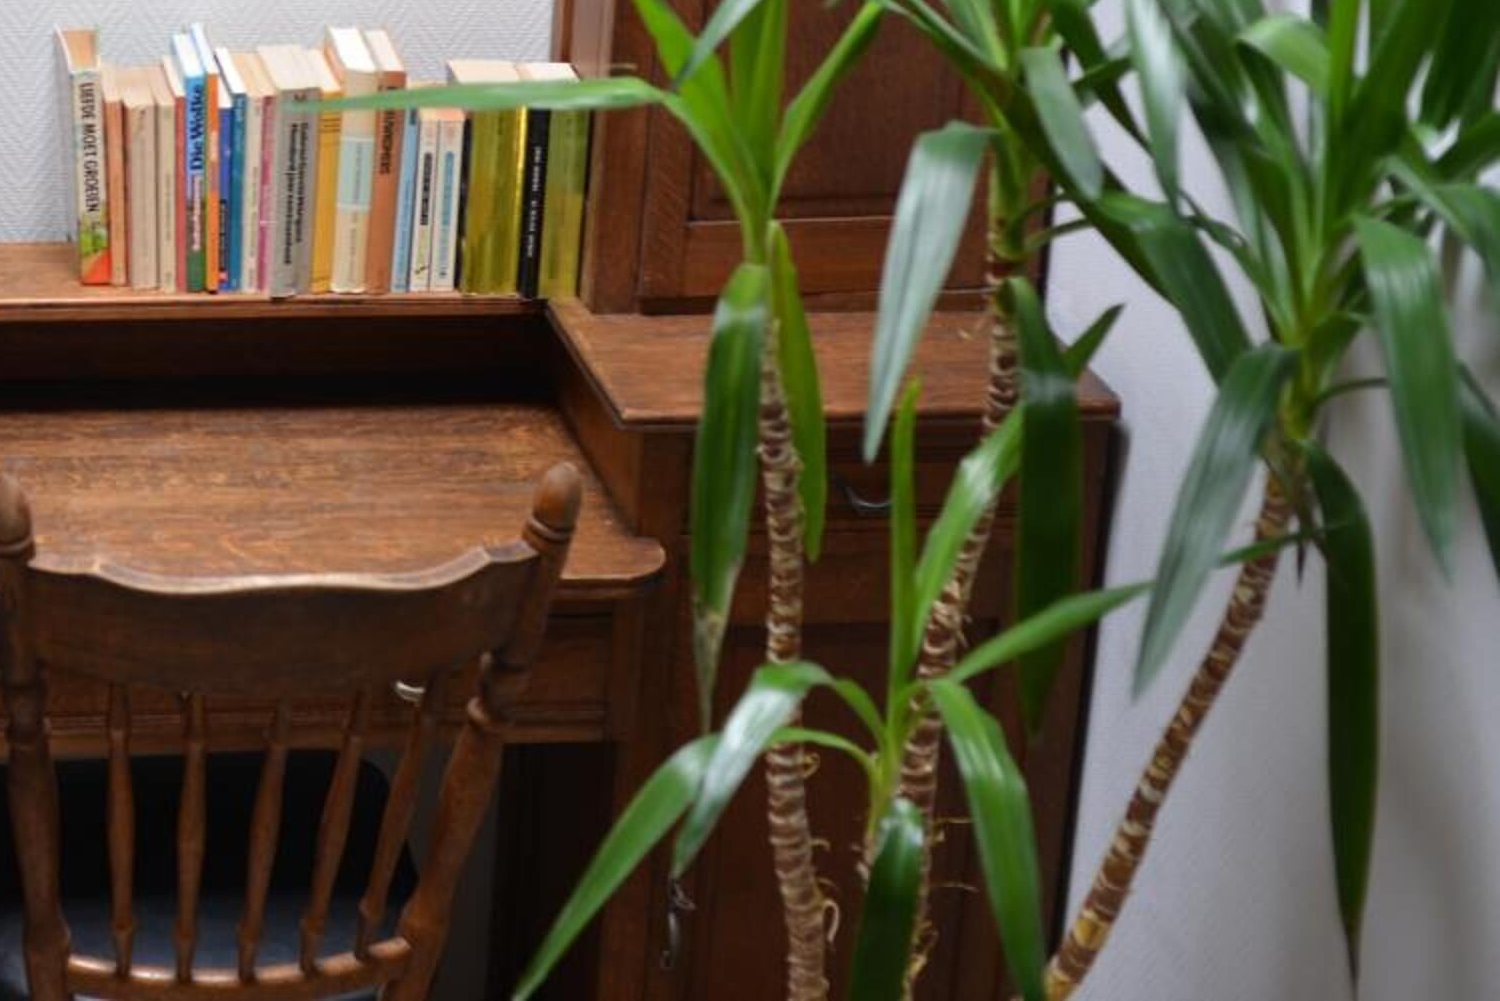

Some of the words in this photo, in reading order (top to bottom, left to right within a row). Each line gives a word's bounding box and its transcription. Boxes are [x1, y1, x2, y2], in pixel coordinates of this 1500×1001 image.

[78, 81, 97, 120] LIEFDE
[187, 85, 205, 141] Wolke
[81, 122, 99, 158] MOET
[188, 142, 205, 172] Die
[83, 160, 101, 213] GROEIEN
